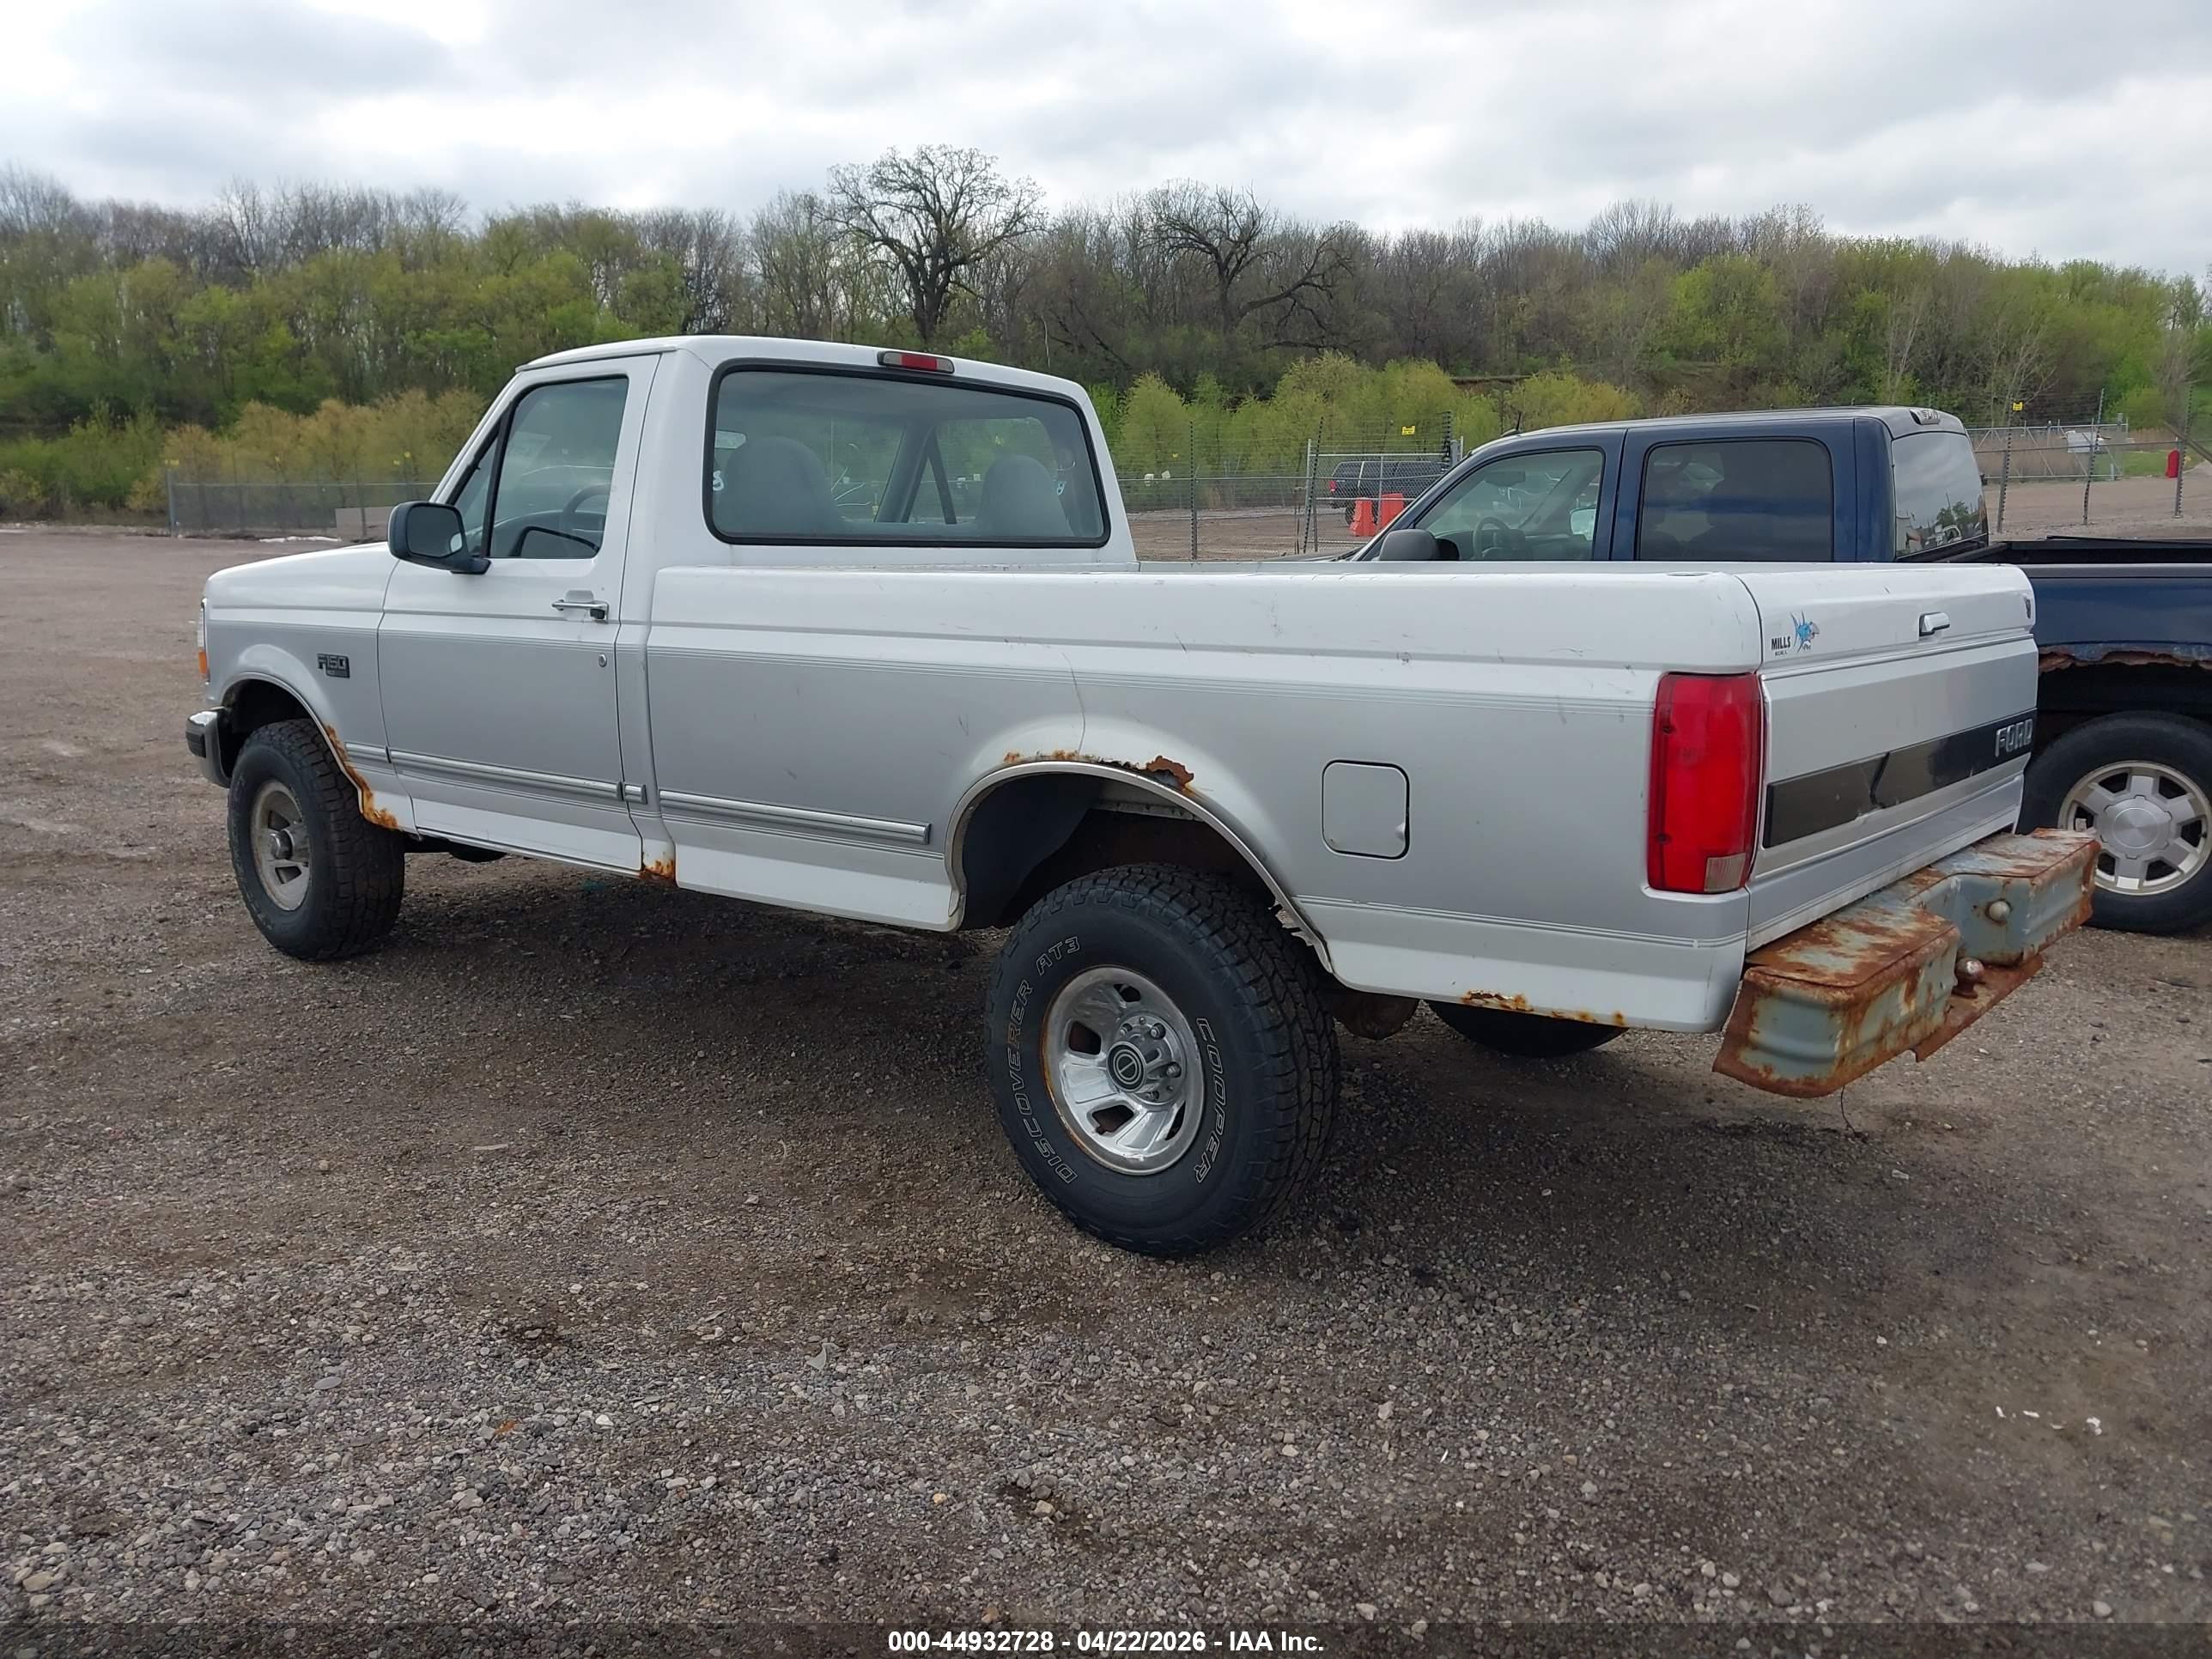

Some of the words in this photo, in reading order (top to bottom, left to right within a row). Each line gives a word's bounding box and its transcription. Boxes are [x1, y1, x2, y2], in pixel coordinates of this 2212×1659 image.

[1771, 636, 1791, 651] MILLS
[1995, 718, 2033, 757] FORD
[1035, 936, 1081, 976] AT3
[1005, 979, 1079, 1184] DISCOVERER
[1194, 1018, 1226, 1184] COOPER
